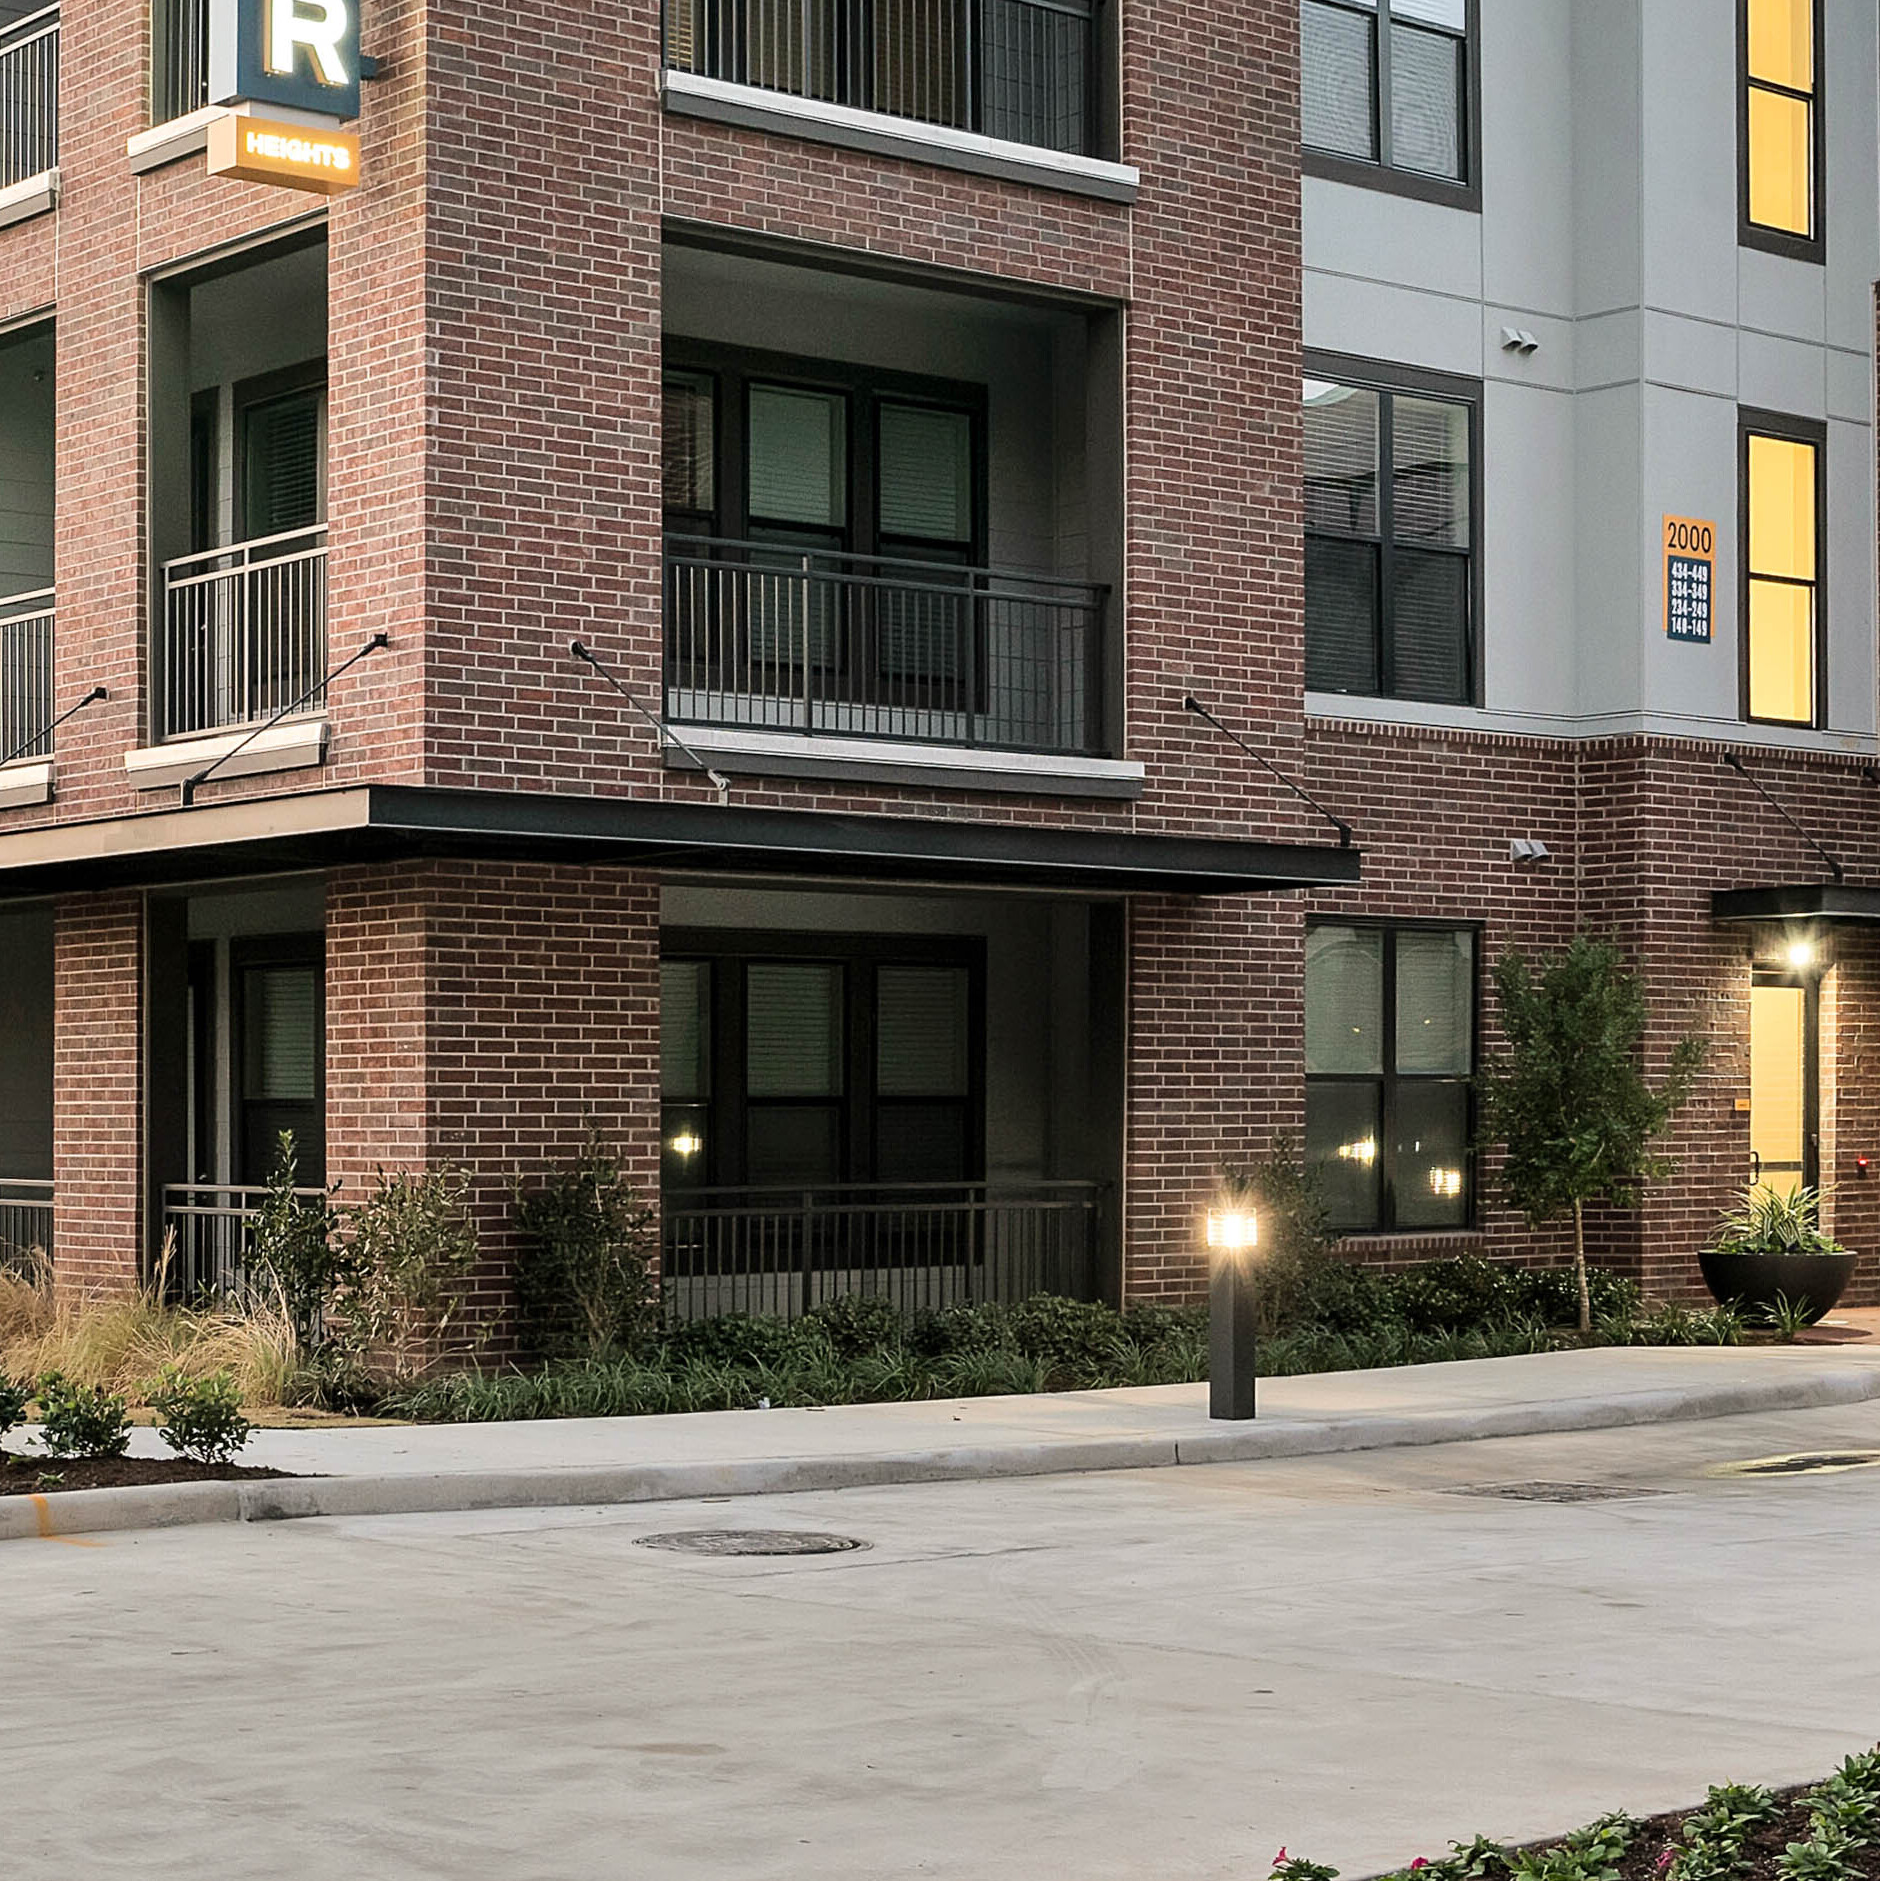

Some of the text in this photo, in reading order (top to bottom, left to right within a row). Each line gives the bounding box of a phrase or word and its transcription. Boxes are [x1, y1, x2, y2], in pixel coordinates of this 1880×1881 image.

[246, 132, 351, 169] HEIGHTS
[1668, 522, 1712, 553] 2000
[1671, 561, 1708, 582] 434-449
[1671, 579, 1708, 601] 334-349
[1671, 597, 1708, 619] 234-249
